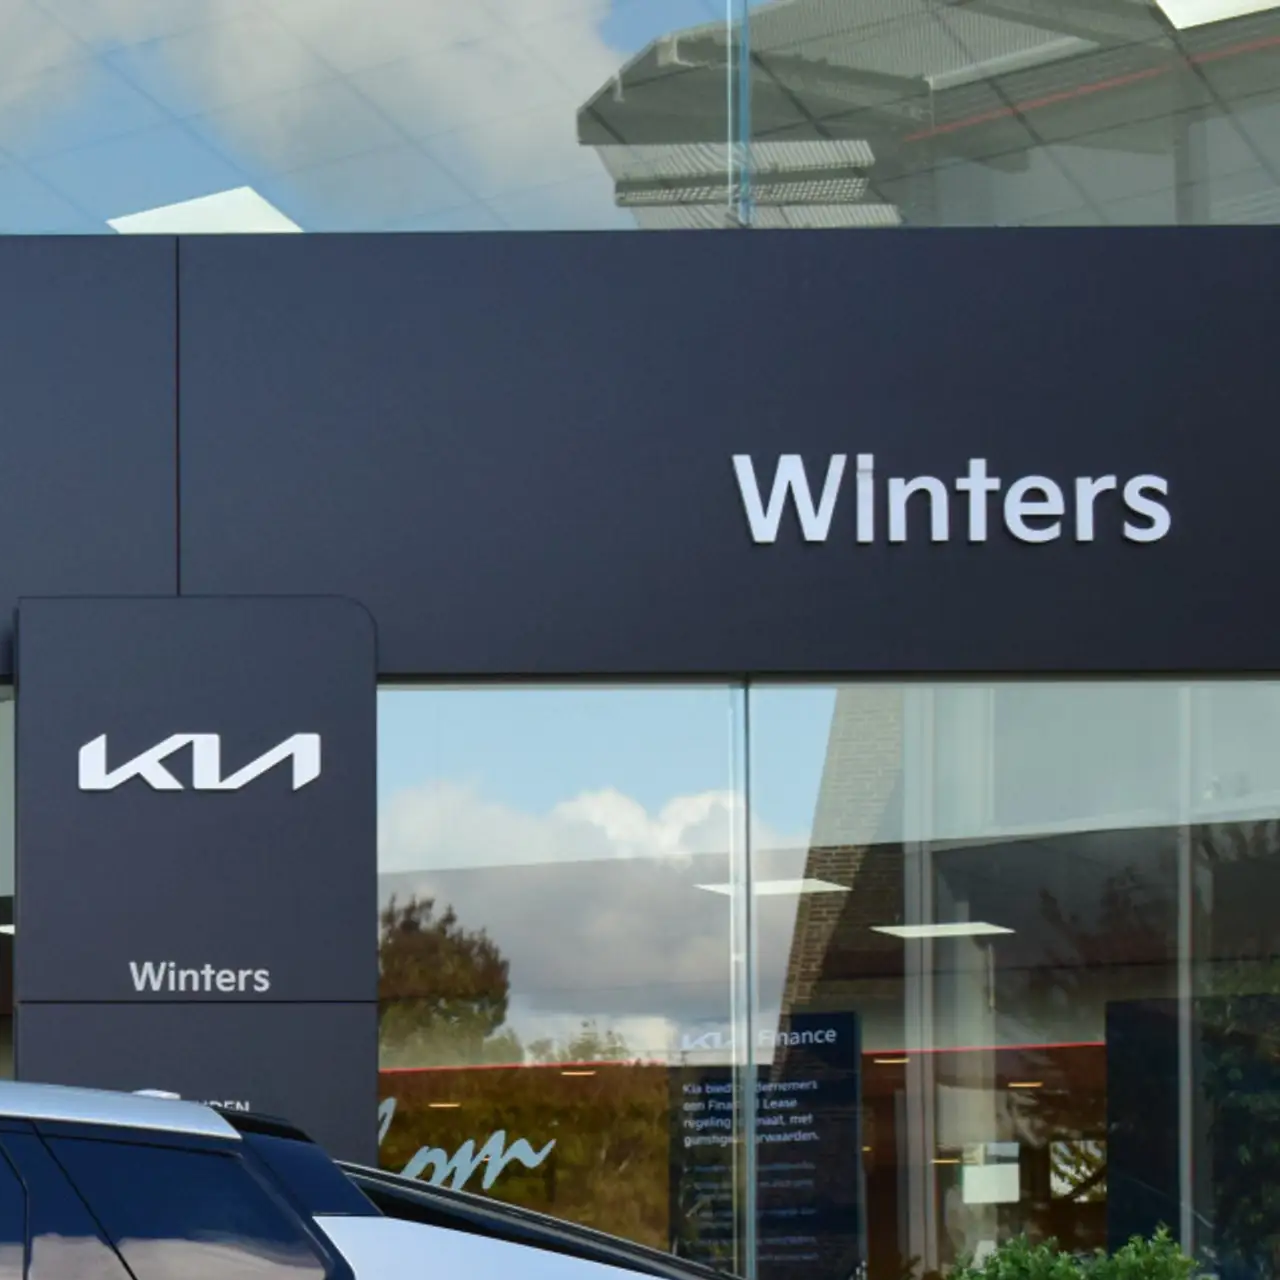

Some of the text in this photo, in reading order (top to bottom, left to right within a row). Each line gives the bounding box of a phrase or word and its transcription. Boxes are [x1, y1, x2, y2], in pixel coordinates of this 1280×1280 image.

[732, 453, 1172, 543] Winters
[78, 732, 321, 791] KIA
[129, 961, 271, 992] Winters
